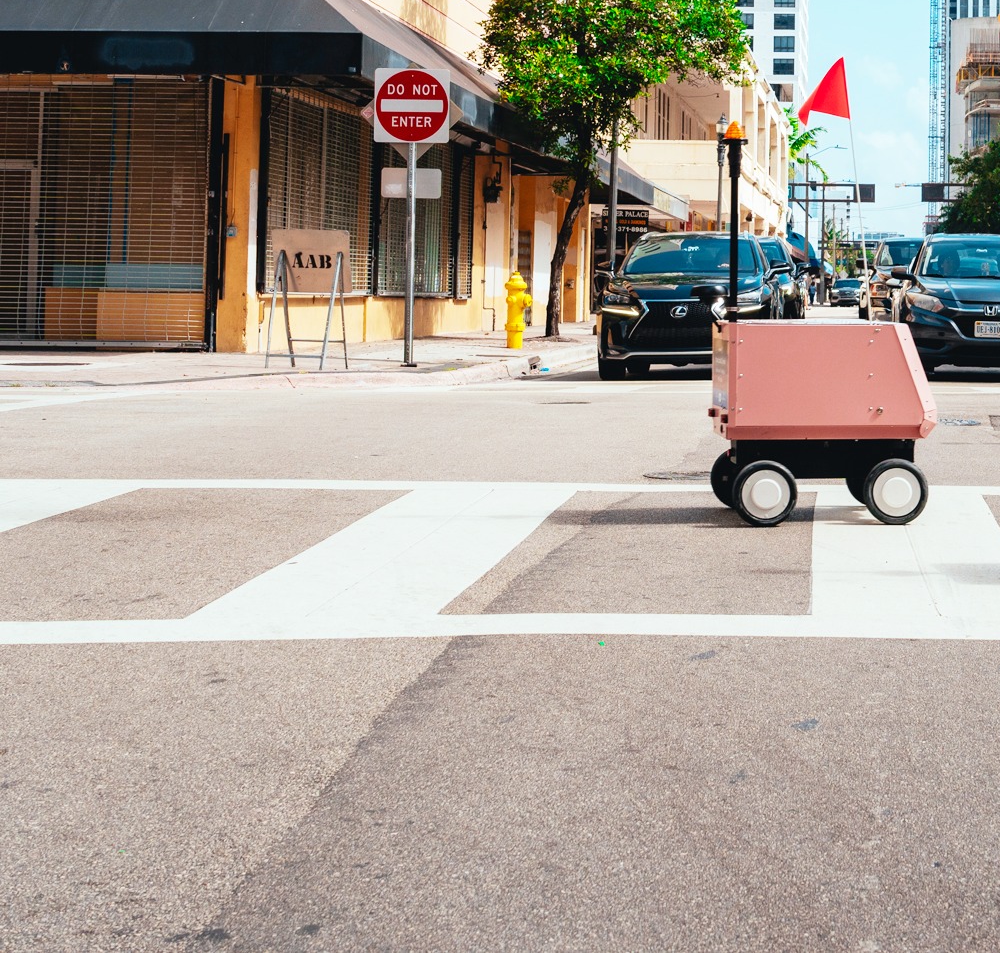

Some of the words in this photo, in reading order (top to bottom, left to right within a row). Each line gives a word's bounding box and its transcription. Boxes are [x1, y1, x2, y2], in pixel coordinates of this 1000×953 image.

[387, 83, 405, 95] DO
[412, 84, 438, 96] NOT
[391, 116, 432, 127] ENTER
